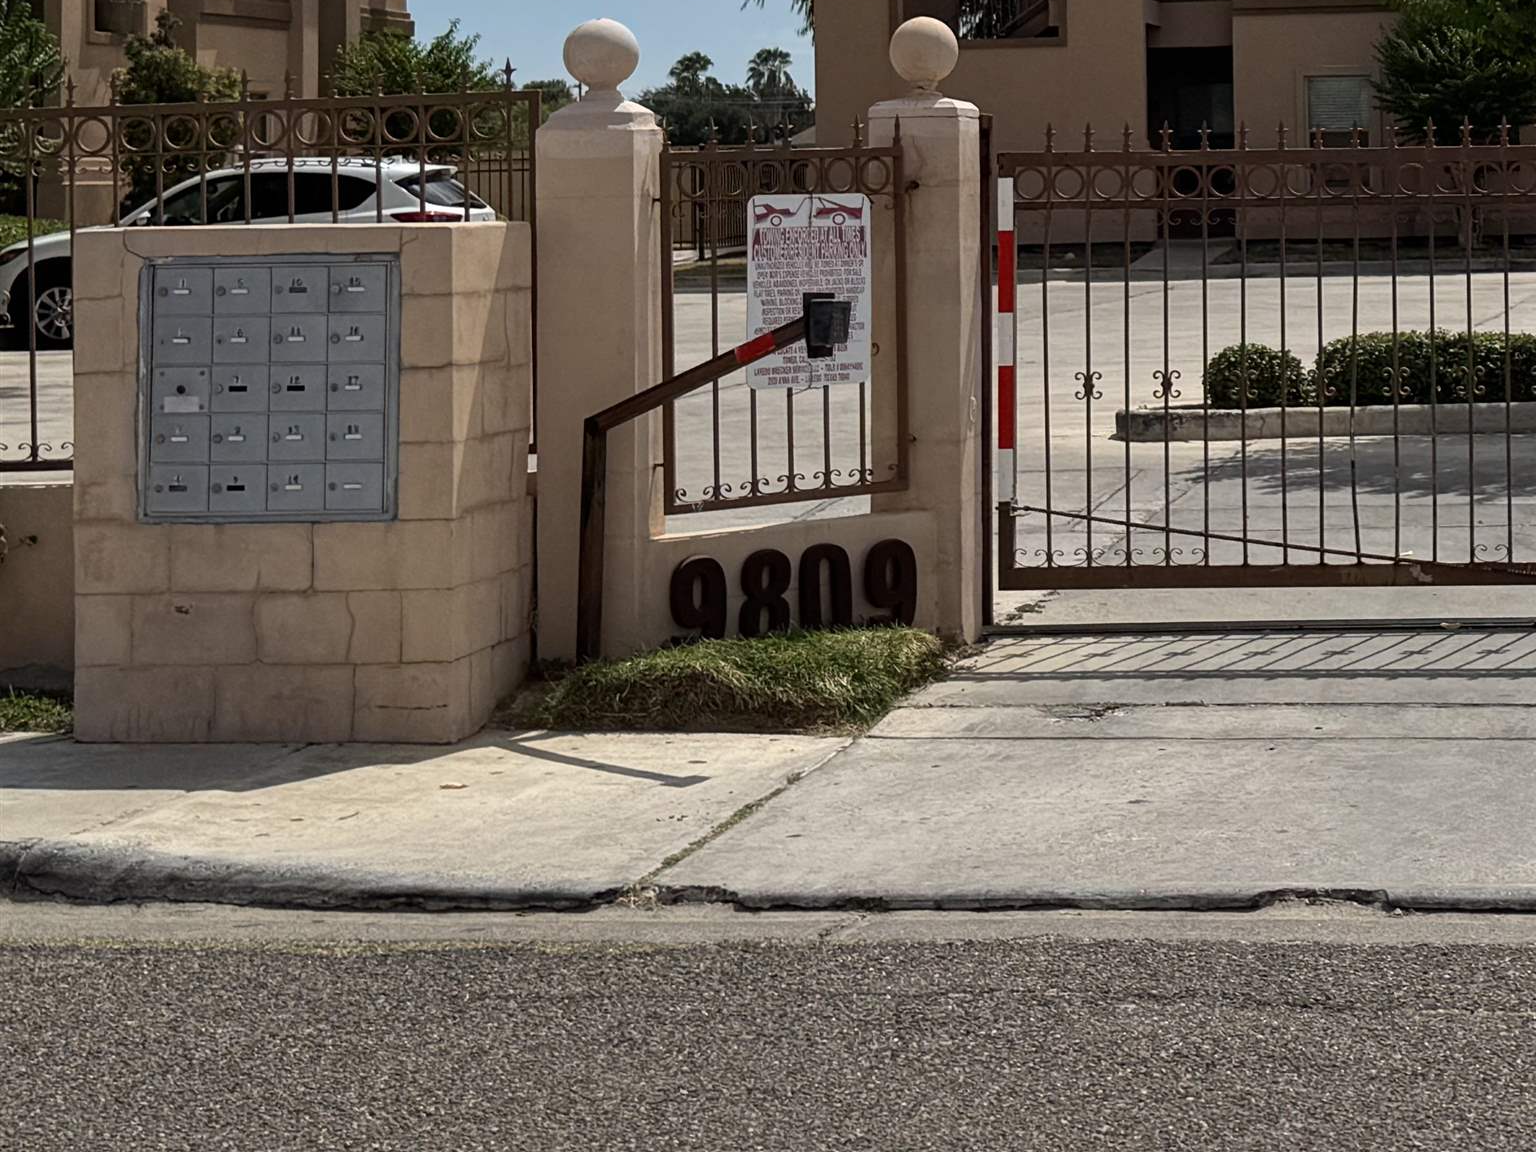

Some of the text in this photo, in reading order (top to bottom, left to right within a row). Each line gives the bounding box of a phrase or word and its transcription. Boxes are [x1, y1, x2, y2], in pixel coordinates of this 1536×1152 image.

[760, 227, 785, 245] TOWING
[786, 227, 819, 244] ENFORCED
[830, 226, 841, 242] ALL
[842, 226, 861, 242] TIMES
[669, 538, 918, 641] 9809
